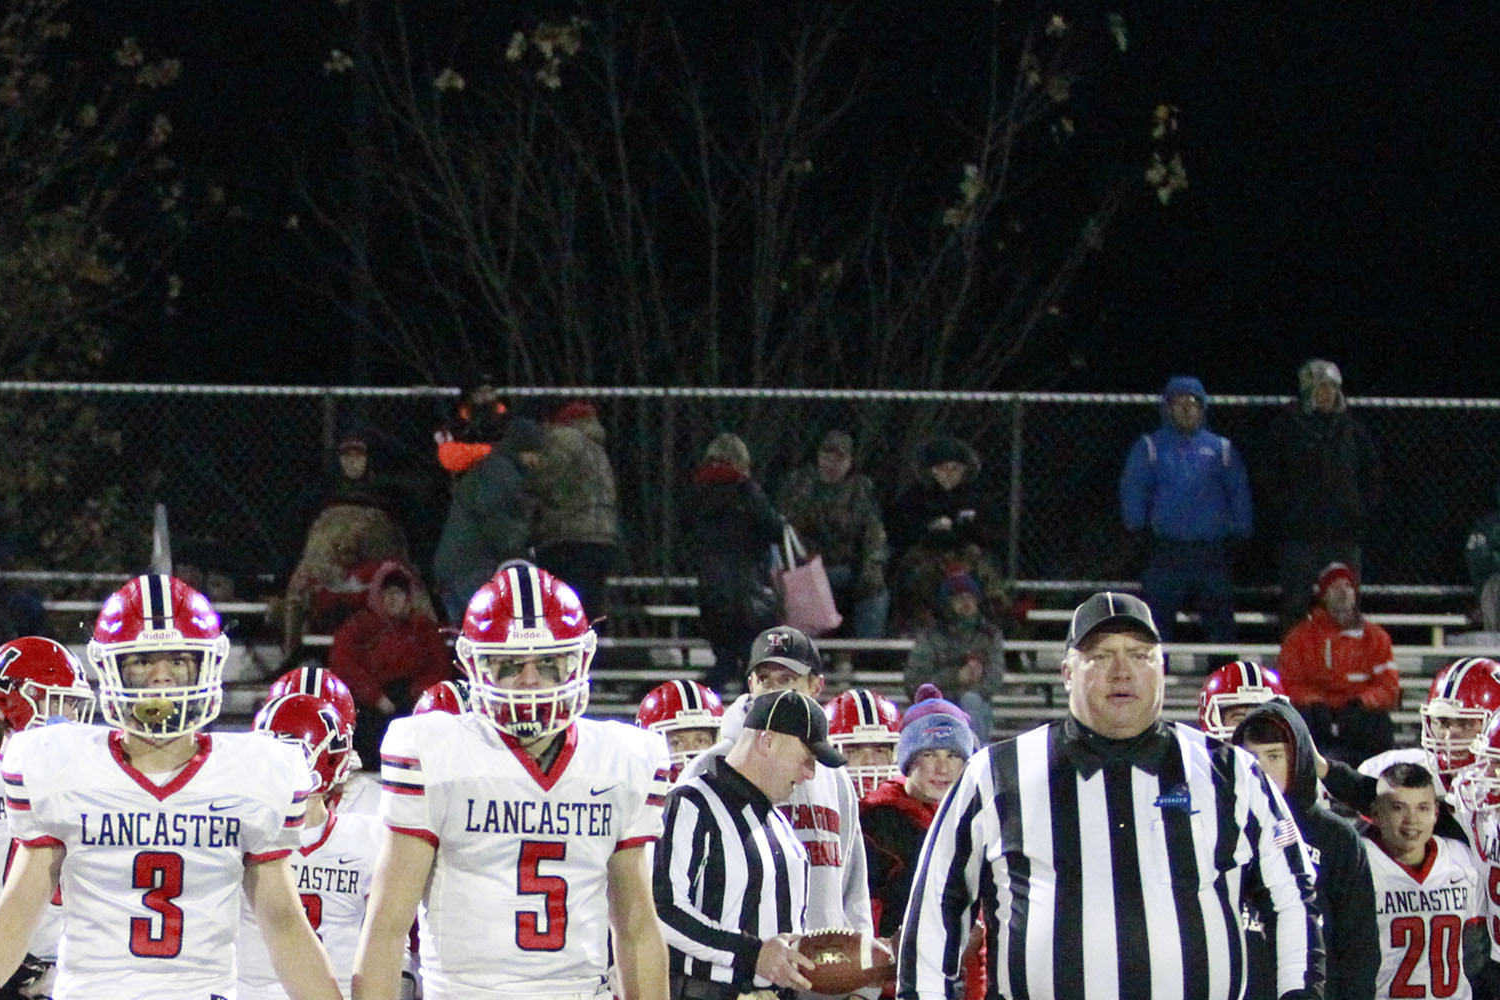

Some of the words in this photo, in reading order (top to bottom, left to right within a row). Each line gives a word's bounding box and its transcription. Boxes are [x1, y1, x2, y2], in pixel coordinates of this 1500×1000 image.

[142, 631, 177, 640] Riddell
[80, 812, 242, 848] LANCASTER
[465, 799, 613, 837] LANCASTER
[291, 864, 359, 895] ASTER
[516, 840, 568, 951] 5
[129, 851, 184, 959] 3
[1389, 914, 1462, 999] 20
